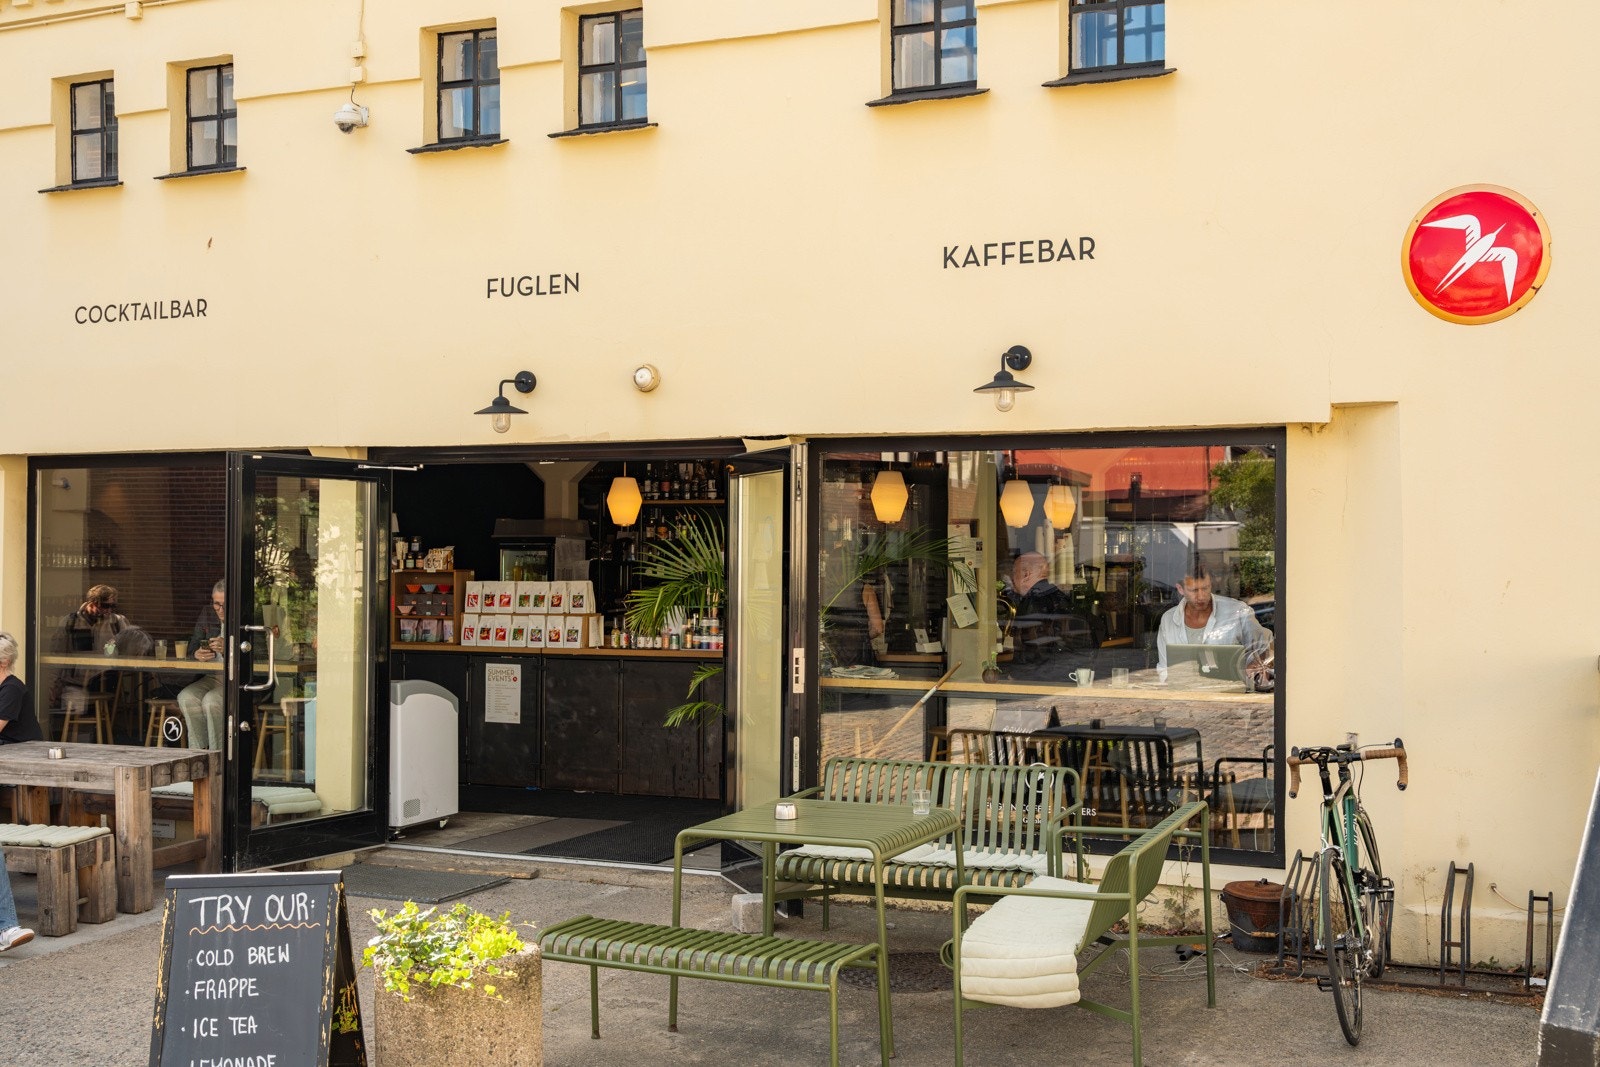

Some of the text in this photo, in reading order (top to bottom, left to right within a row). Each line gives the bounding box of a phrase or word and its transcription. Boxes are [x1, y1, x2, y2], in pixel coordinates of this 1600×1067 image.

[943, 236, 1096, 269] KAFFEBAR
[486, 272, 580, 299] FUGLEN
[74, 298, 208, 325] COCKTAILBAR
[189, 892, 315, 926] TRY OUR:
[196, 943, 290, 967] COLD BREW
[194, 977, 260, 1000] FRAPPE
[194, 1015, 259, 1038] ICE TEA
